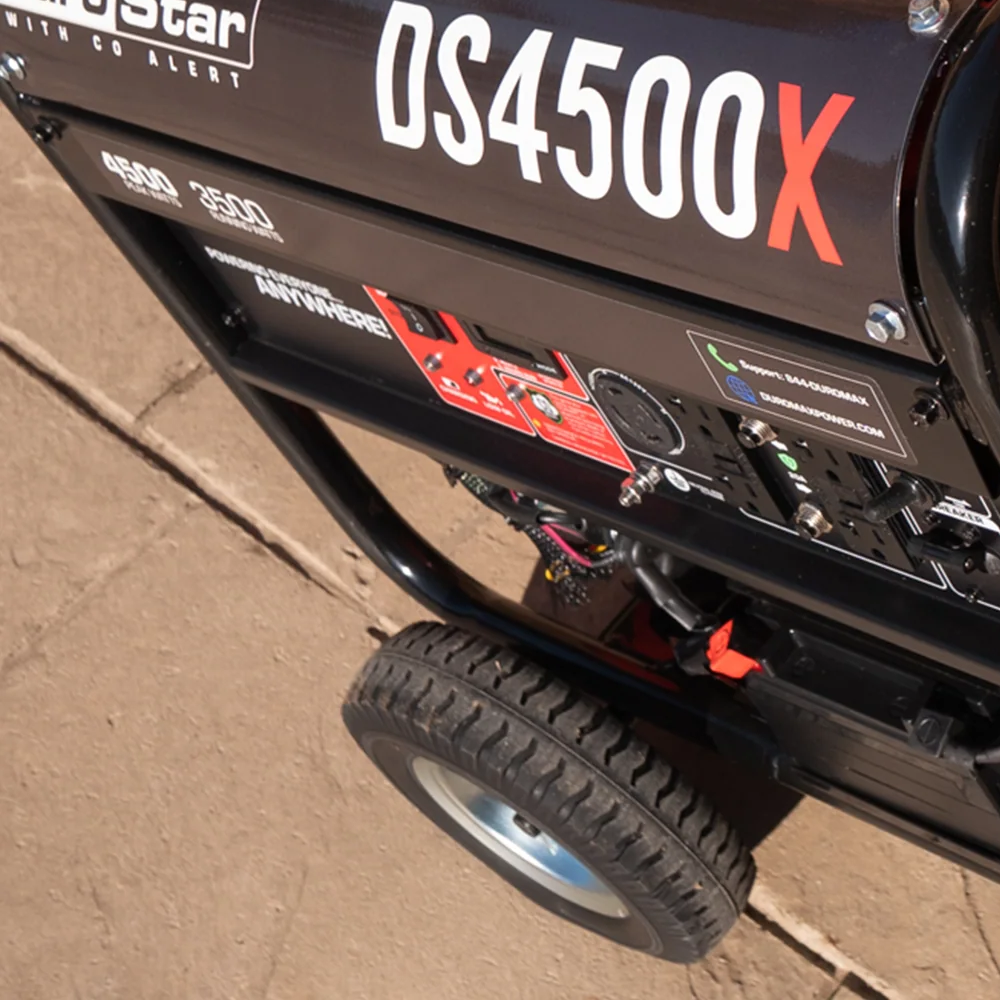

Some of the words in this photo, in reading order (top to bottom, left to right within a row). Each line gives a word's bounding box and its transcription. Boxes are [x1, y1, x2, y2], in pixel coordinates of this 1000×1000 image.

[5, 11, 69, 42] WITH
[92, 34, 122, 57] CO
[149, 50, 240, 89] ALERT
[375, 0, 856, 267] DS4500X
[101, 150, 179, 198] 4500
[188, 180, 275, 231] 3500
[204, 246, 270, 278] POWERING
[254, 274, 393, 340] ANYWHERE!
[759, 391, 886, 439] DUROMAXPOWER.COM
